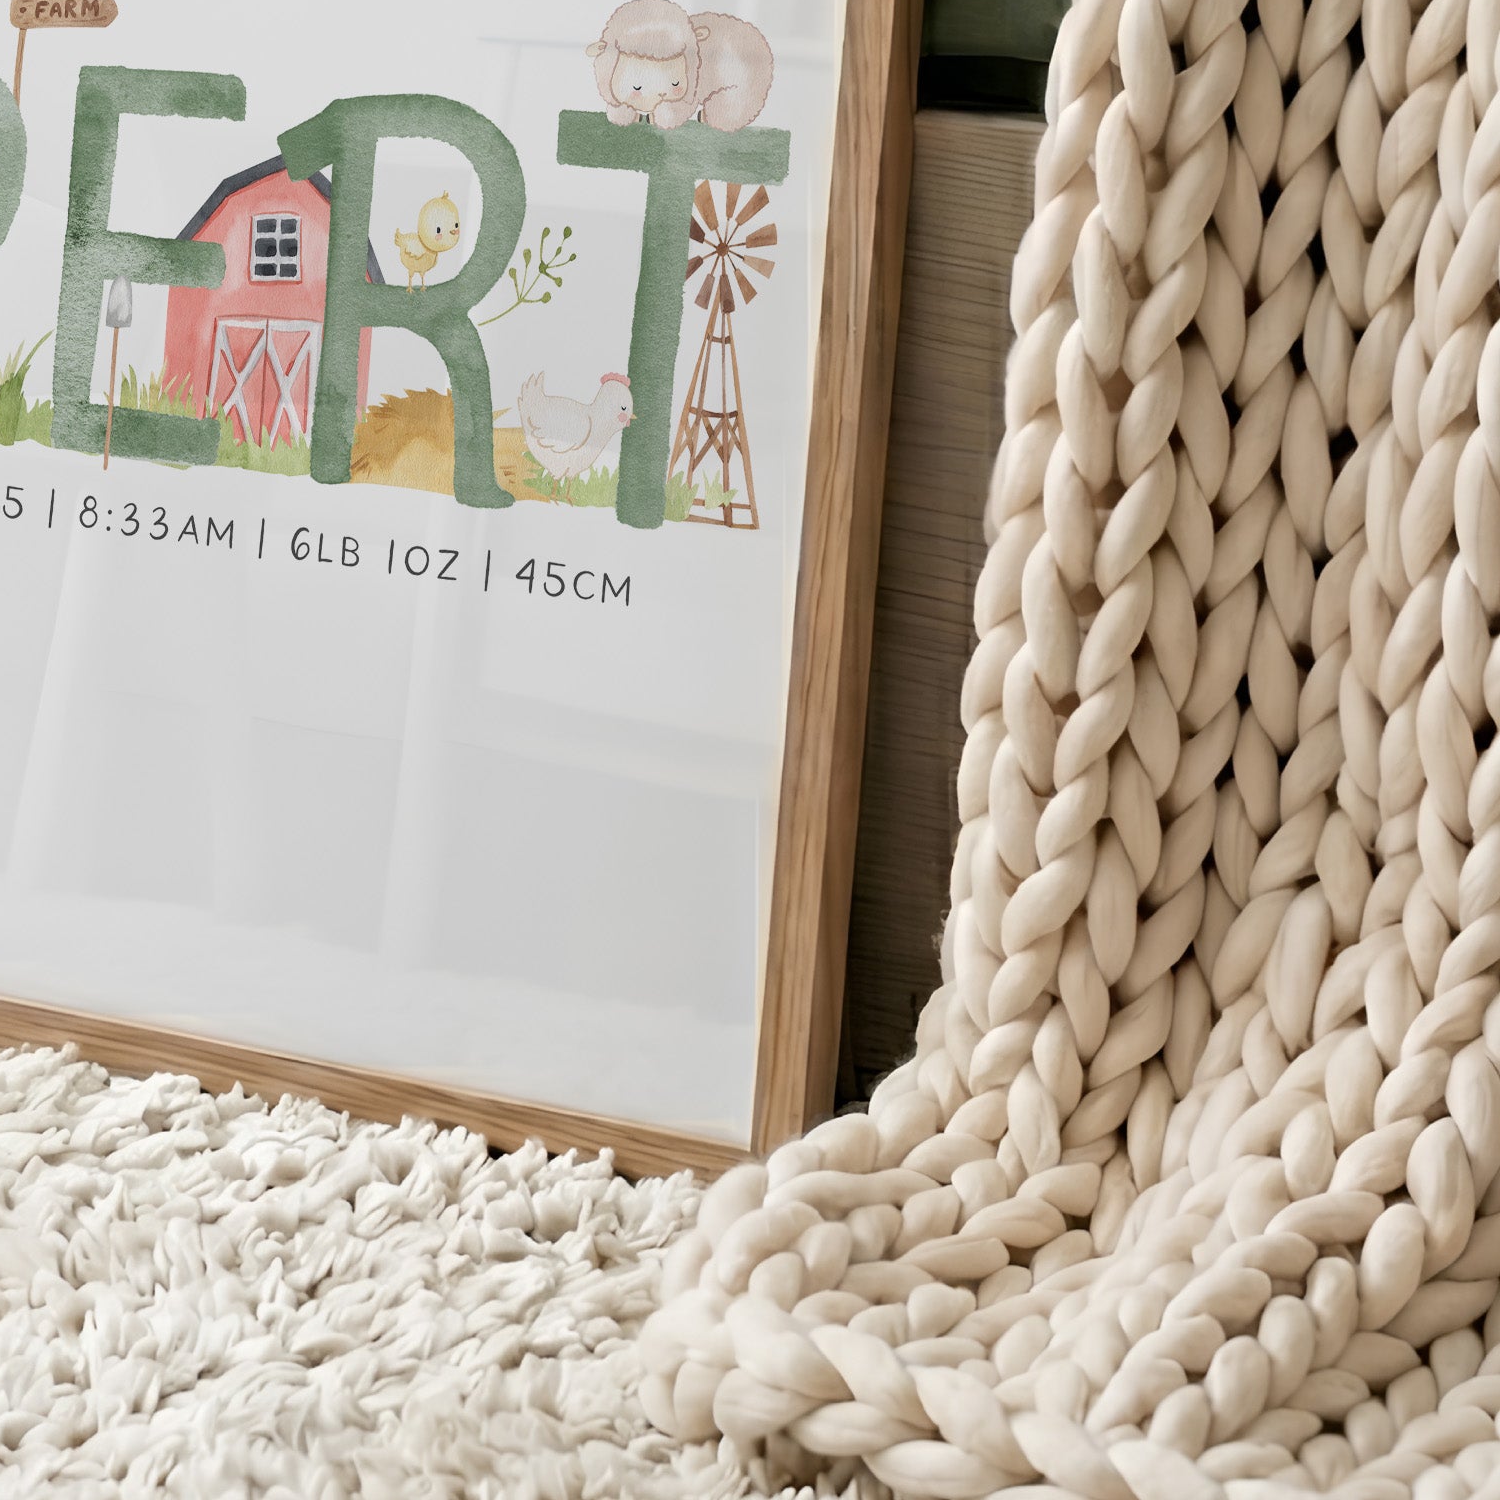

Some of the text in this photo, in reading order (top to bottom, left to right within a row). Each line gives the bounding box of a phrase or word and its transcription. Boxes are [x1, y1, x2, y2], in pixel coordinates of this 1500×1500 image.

[78, 495, 235, 550] 8:33AM
[290, 526, 361, 568] 6LB
[515, 558, 632, 607] 45CM
